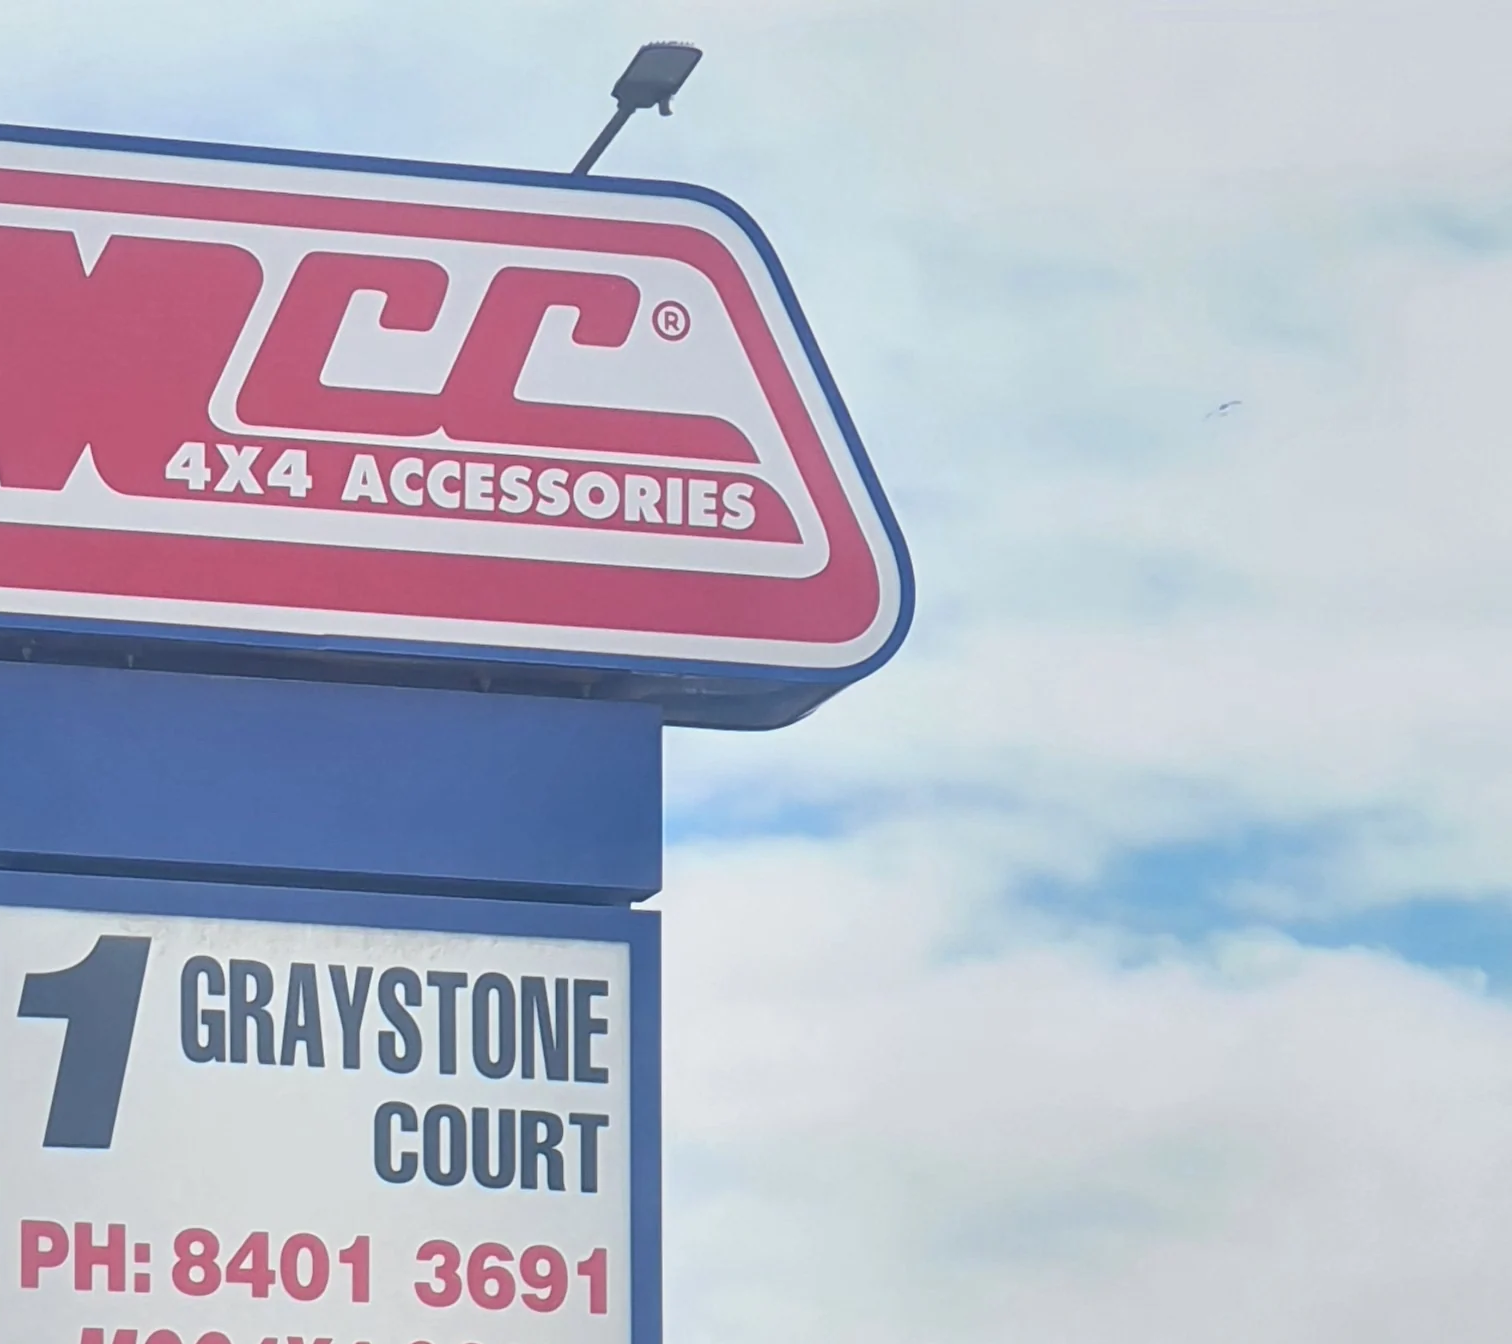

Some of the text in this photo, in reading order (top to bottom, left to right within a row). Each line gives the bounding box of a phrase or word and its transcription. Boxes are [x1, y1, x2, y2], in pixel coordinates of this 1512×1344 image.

[165, 441, 757, 531] 4X4 ACCESSORIES
[16, 934, 609, 1149] 1 GRAYSTONE
[373, 1100, 609, 1194] COURT
[19, 1218, 608, 1315] PH: 8401 3691
